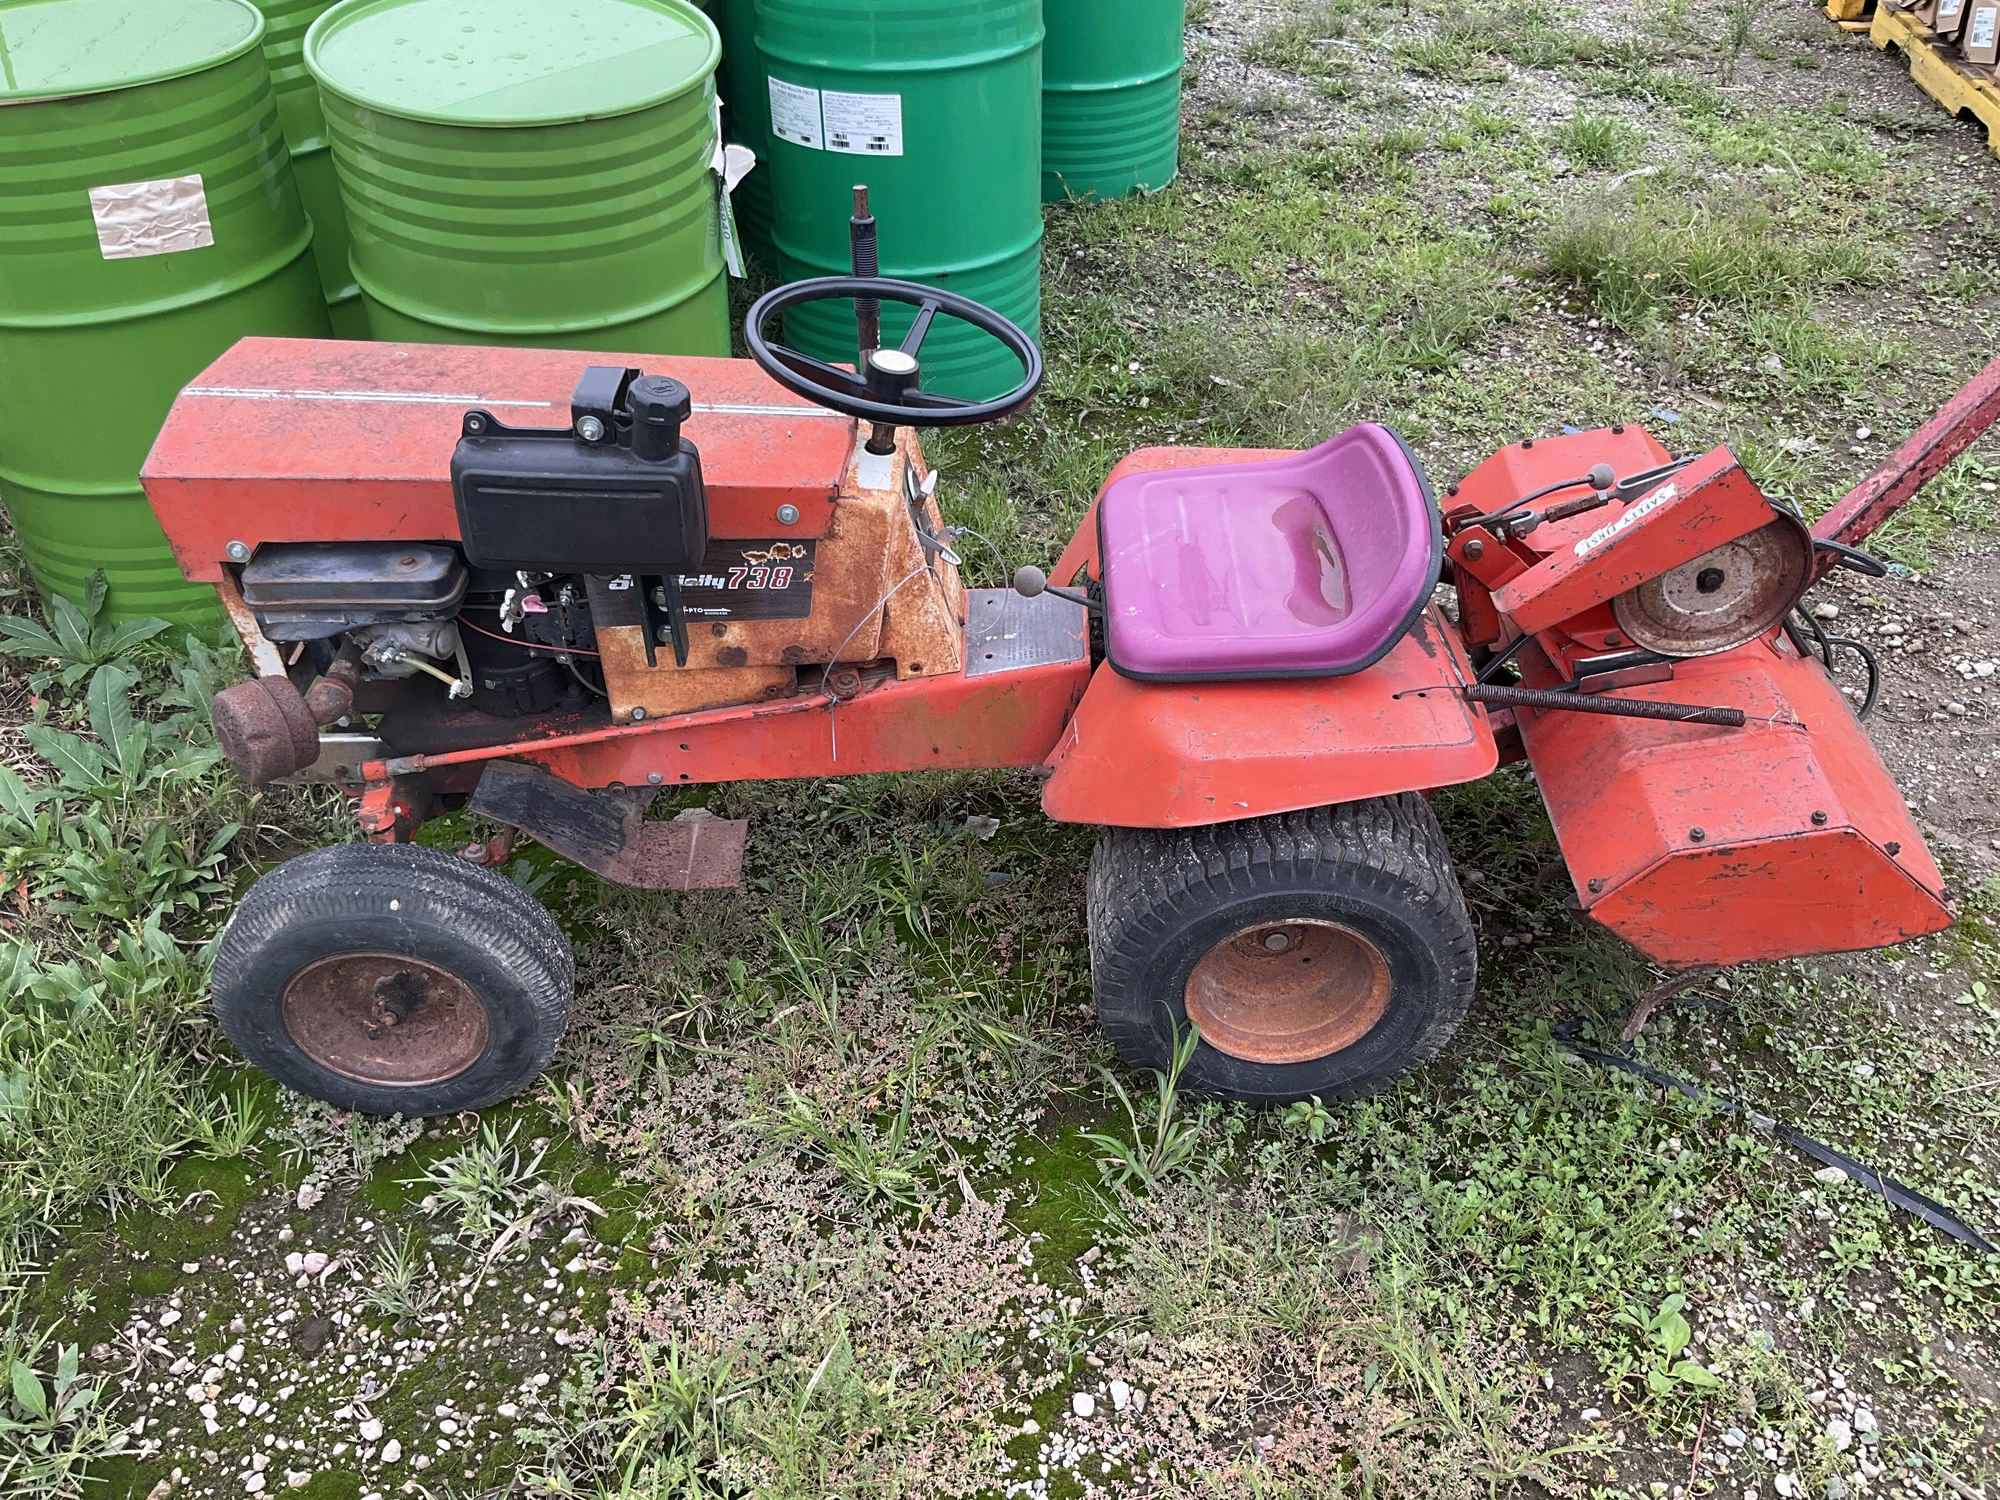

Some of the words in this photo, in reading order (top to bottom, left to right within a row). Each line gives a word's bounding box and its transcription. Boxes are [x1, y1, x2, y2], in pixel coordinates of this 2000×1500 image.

[1623, 491, 1667, 525] SAFETY
[1585, 525, 1617, 549] FIRST
[608, 574, 726, 590] Sicity
[728, 566, 794, 590] 738
